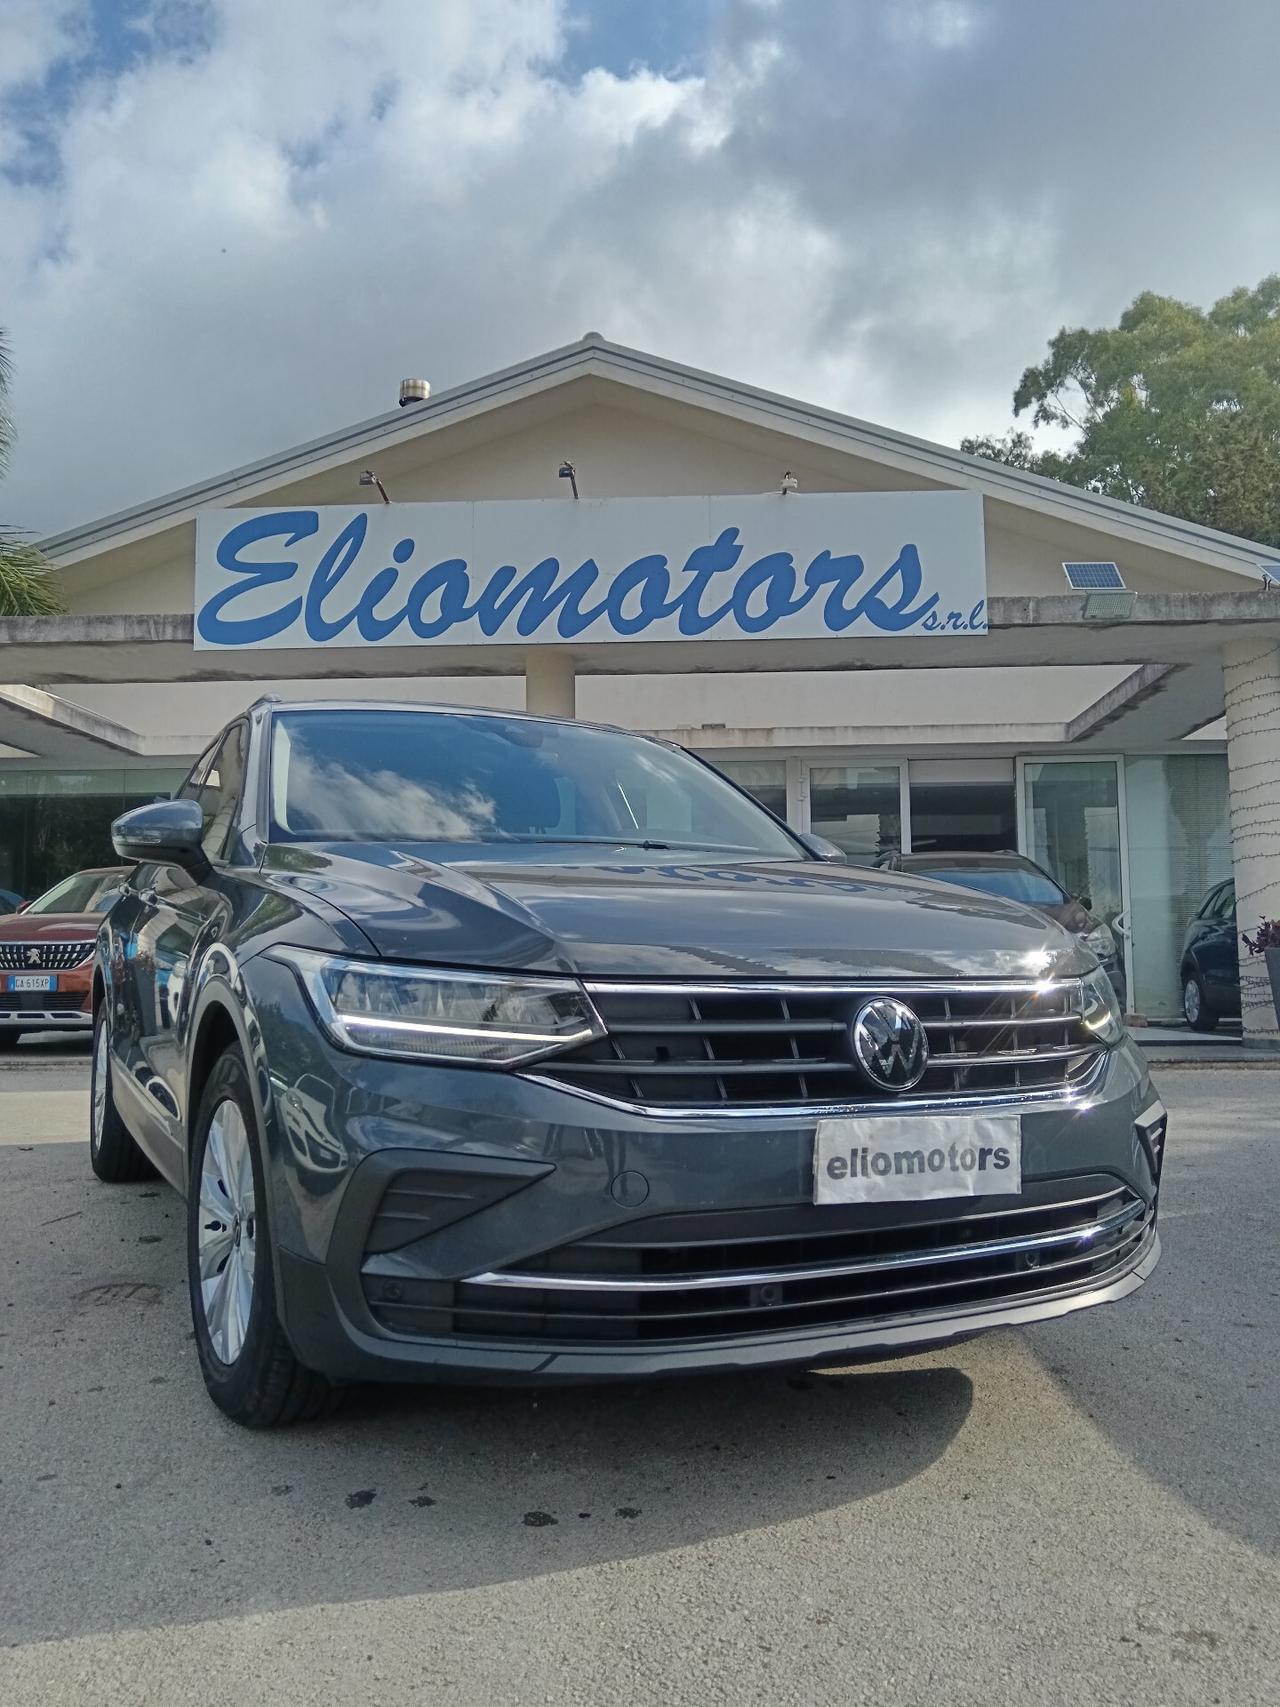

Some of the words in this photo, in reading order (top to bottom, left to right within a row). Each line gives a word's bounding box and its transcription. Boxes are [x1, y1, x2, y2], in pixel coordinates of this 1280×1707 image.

[197, 511, 941, 645] Eliomotors
[921, 599, 988, 631] s.r.l.
[826, 1142, 1011, 1180] eliomotors
